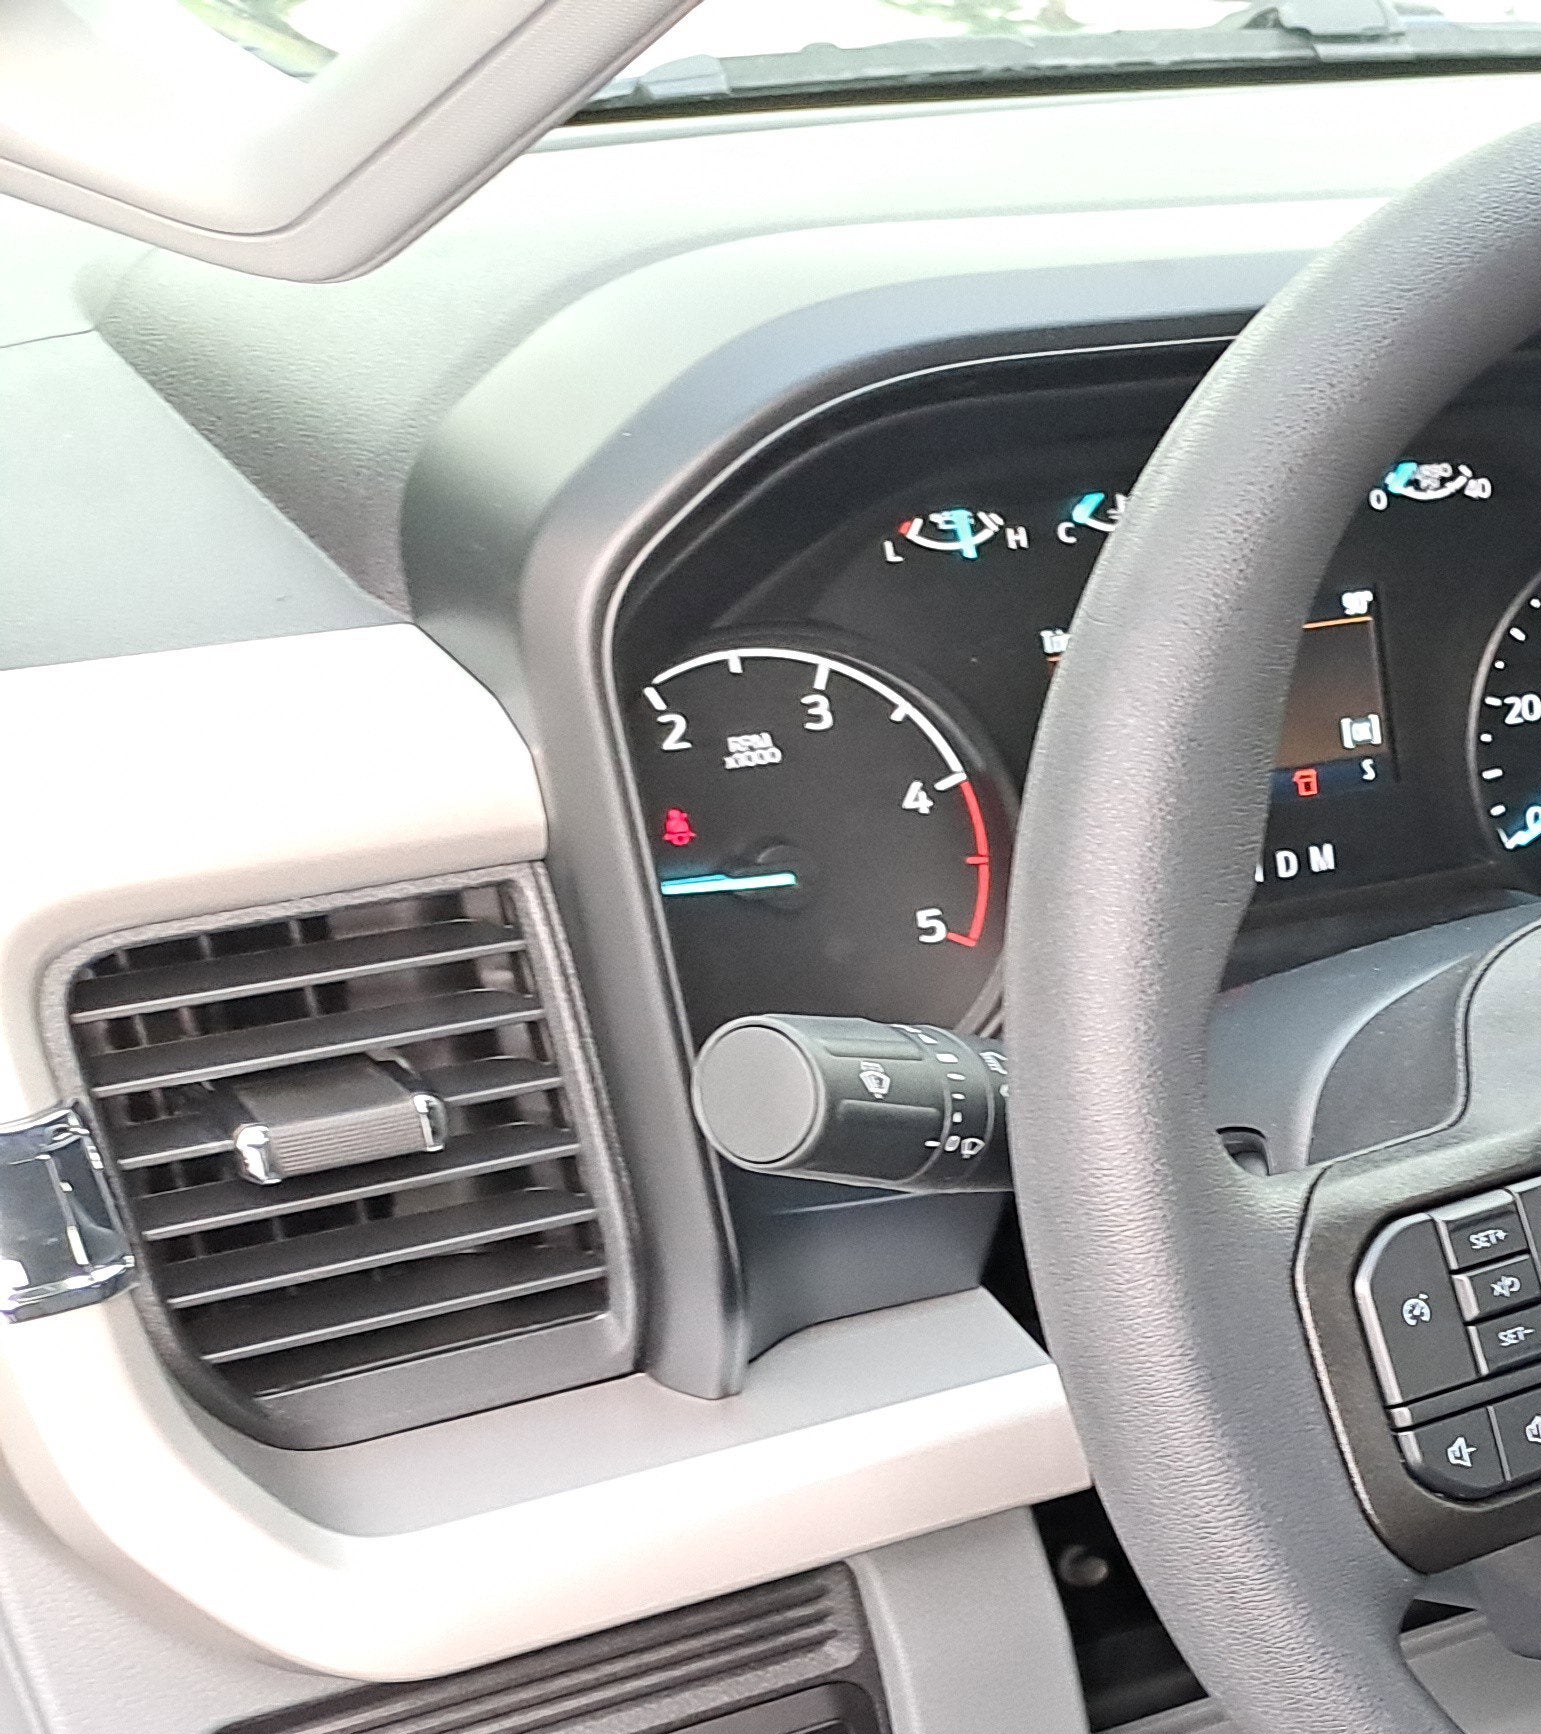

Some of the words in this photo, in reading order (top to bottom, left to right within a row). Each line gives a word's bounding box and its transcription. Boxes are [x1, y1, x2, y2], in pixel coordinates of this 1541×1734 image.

[1369, 488, 1388, 511] 0
[1006, 526, 1029, 549] H
[1057, 522, 1078, 543] C
[883, 540, 904, 562] L
[800, 694, 833, 731] 3
[1504, 693, 1541, 725] 20
[657, 713, 692, 750] 2
[727, 732, 773, 752] RPM
[1362, 759, 1376, 781] S
[902, 780, 934, 814] 4
[1275, 851, 1299, 878] D
[1308, 843, 1335, 873] M
[915, 907, 947, 943] 5
